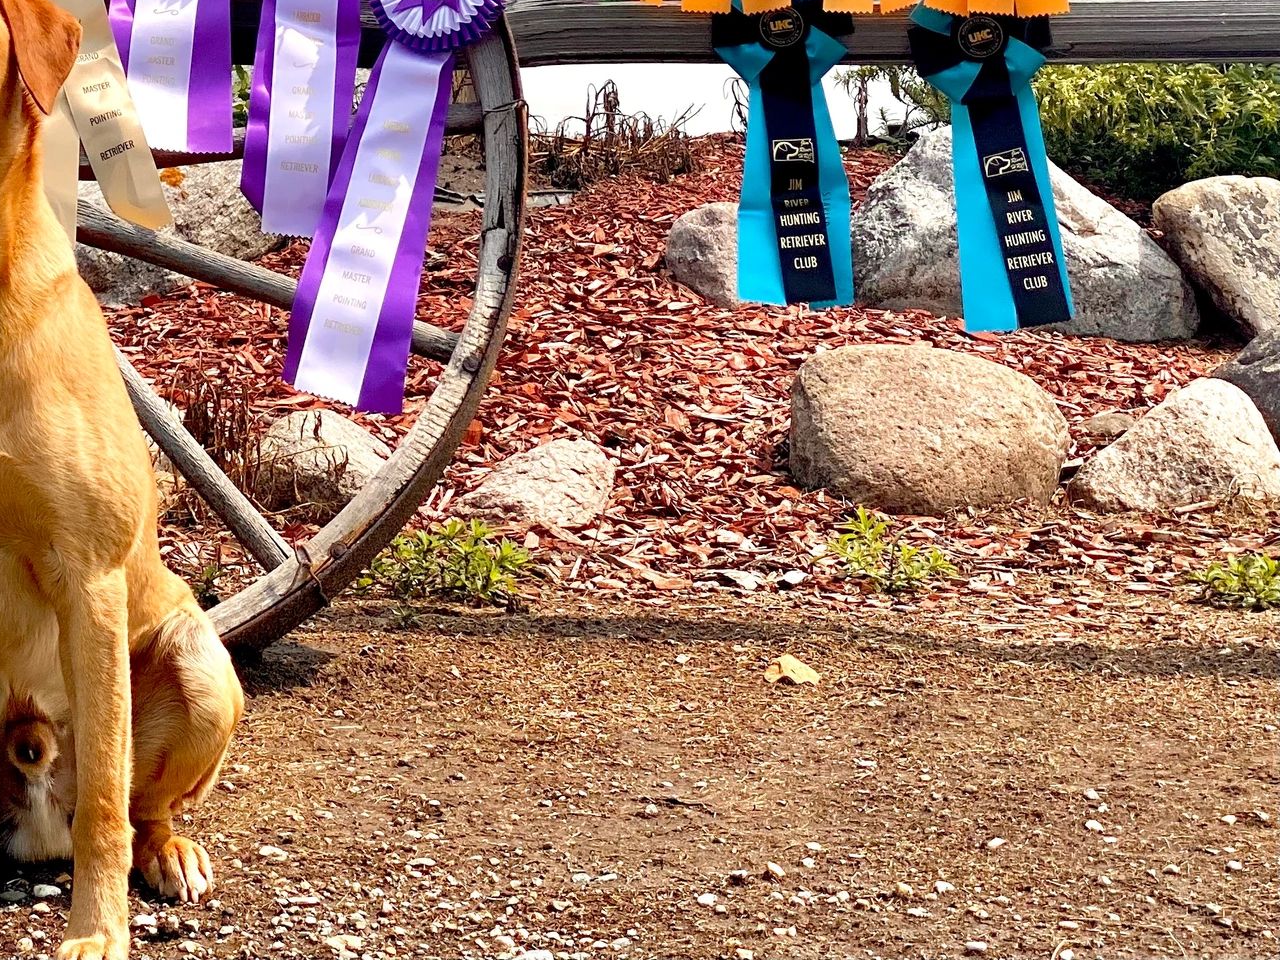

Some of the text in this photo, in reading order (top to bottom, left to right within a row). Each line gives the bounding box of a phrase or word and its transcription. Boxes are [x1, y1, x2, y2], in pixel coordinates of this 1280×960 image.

[769, 18, 794, 31] UKC
[968, 28, 993, 43] UKC
[82, 81, 111, 94] MASTER
[89, 108, 122, 127] POINTING
[100, 139, 135, 161] RETRIEVER
[280, 160, 320, 174] RETRIEVER
[787, 178, 803, 191] JIM
[784, 198, 809, 208] RIVER
[1007, 189, 1023, 203] JIM
[780, 212, 820, 227] HUNTING
[1006, 209, 1034, 225] RIVER
[780, 233, 826, 249] RETRIEVER
[1004, 229, 1046, 248] HUNTING
[350, 244, 376, 258] GRAND
[793, 255, 818, 270] CLUB
[1007, 251, 1054, 271] RETRIEVER
[342, 270, 371, 285] MASTER
[1023, 275, 1048, 291] CLUB
[333, 293, 367, 310] POINTING
